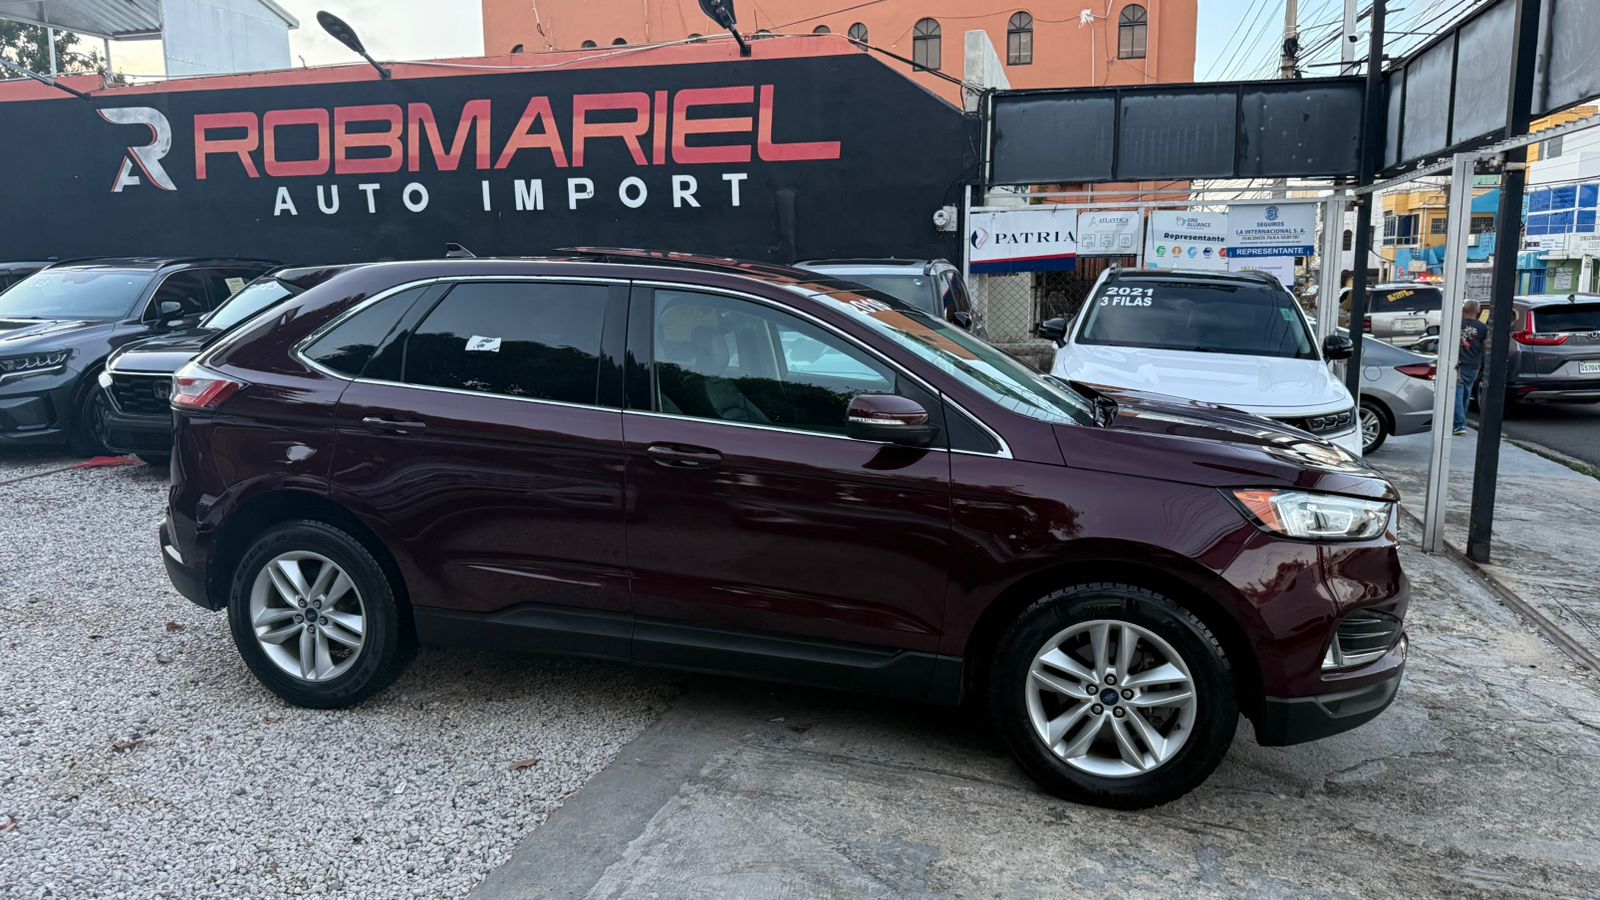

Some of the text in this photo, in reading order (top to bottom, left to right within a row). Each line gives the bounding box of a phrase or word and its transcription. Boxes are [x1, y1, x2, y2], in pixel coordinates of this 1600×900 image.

[194, 84, 841, 179] ROBMARIEL
[273, 172, 750, 216] AUTO IMPORT
[995, 231, 1077, 244] PATRIA
[1164, 232, 1226, 243] Representante
[1236, 247, 1304, 256] REPRESENTANTE
[1106, 287, 1154, 296] 2021
[1100, 296, 1153, 306] 3 FILAS
